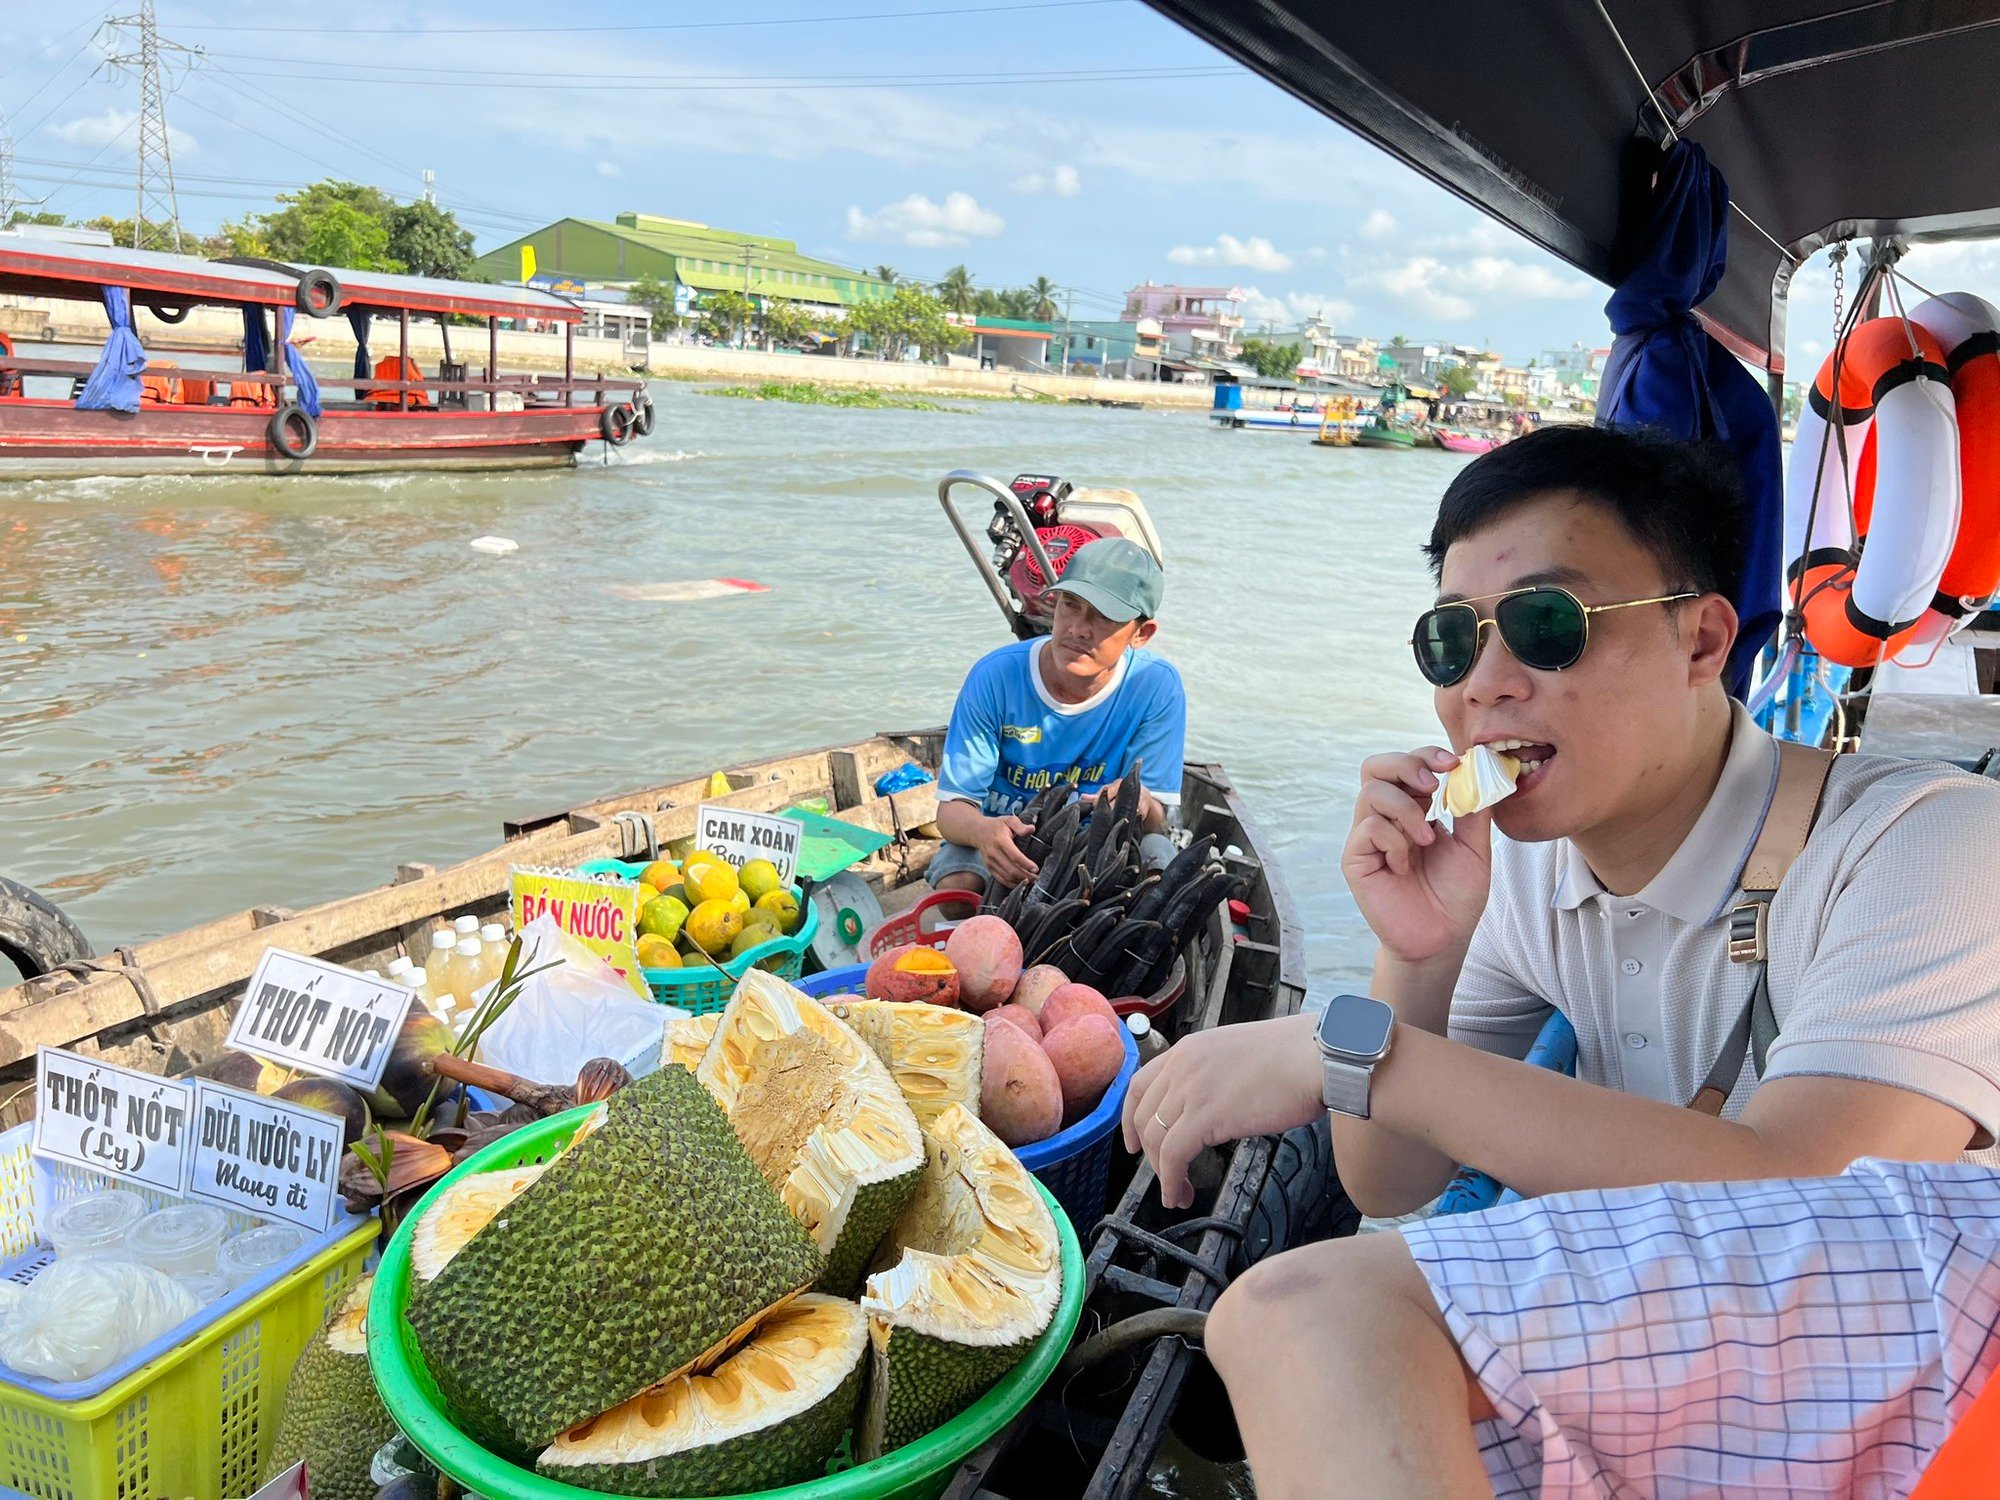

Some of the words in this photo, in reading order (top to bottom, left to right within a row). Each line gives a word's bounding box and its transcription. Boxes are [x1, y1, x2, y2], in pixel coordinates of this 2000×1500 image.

[705, 819, 746, 843] CAM
[750, 824, 796, 855] XOÀN
[523, 888, 564, 928] BÁN
[569, 896, 624, 942] NƯỚC
[248, 975, 333, 1052] THỐT
[322, 993, 391, 1071] NỐT
[47, 1068, 119, 1129] THỐT
[126, 1087, 185, 1148] NỐT
[80, 1126, 146, 1173] (Ly)
[201, 1097, 241, 1157] DỪA
[246, 1114, 302, 1174] NƯỚC
[305, 1135, 333, 1184] LY
[215, 1158, 279, 1207] Mang
[286, 1182, 308, 1211] đi
